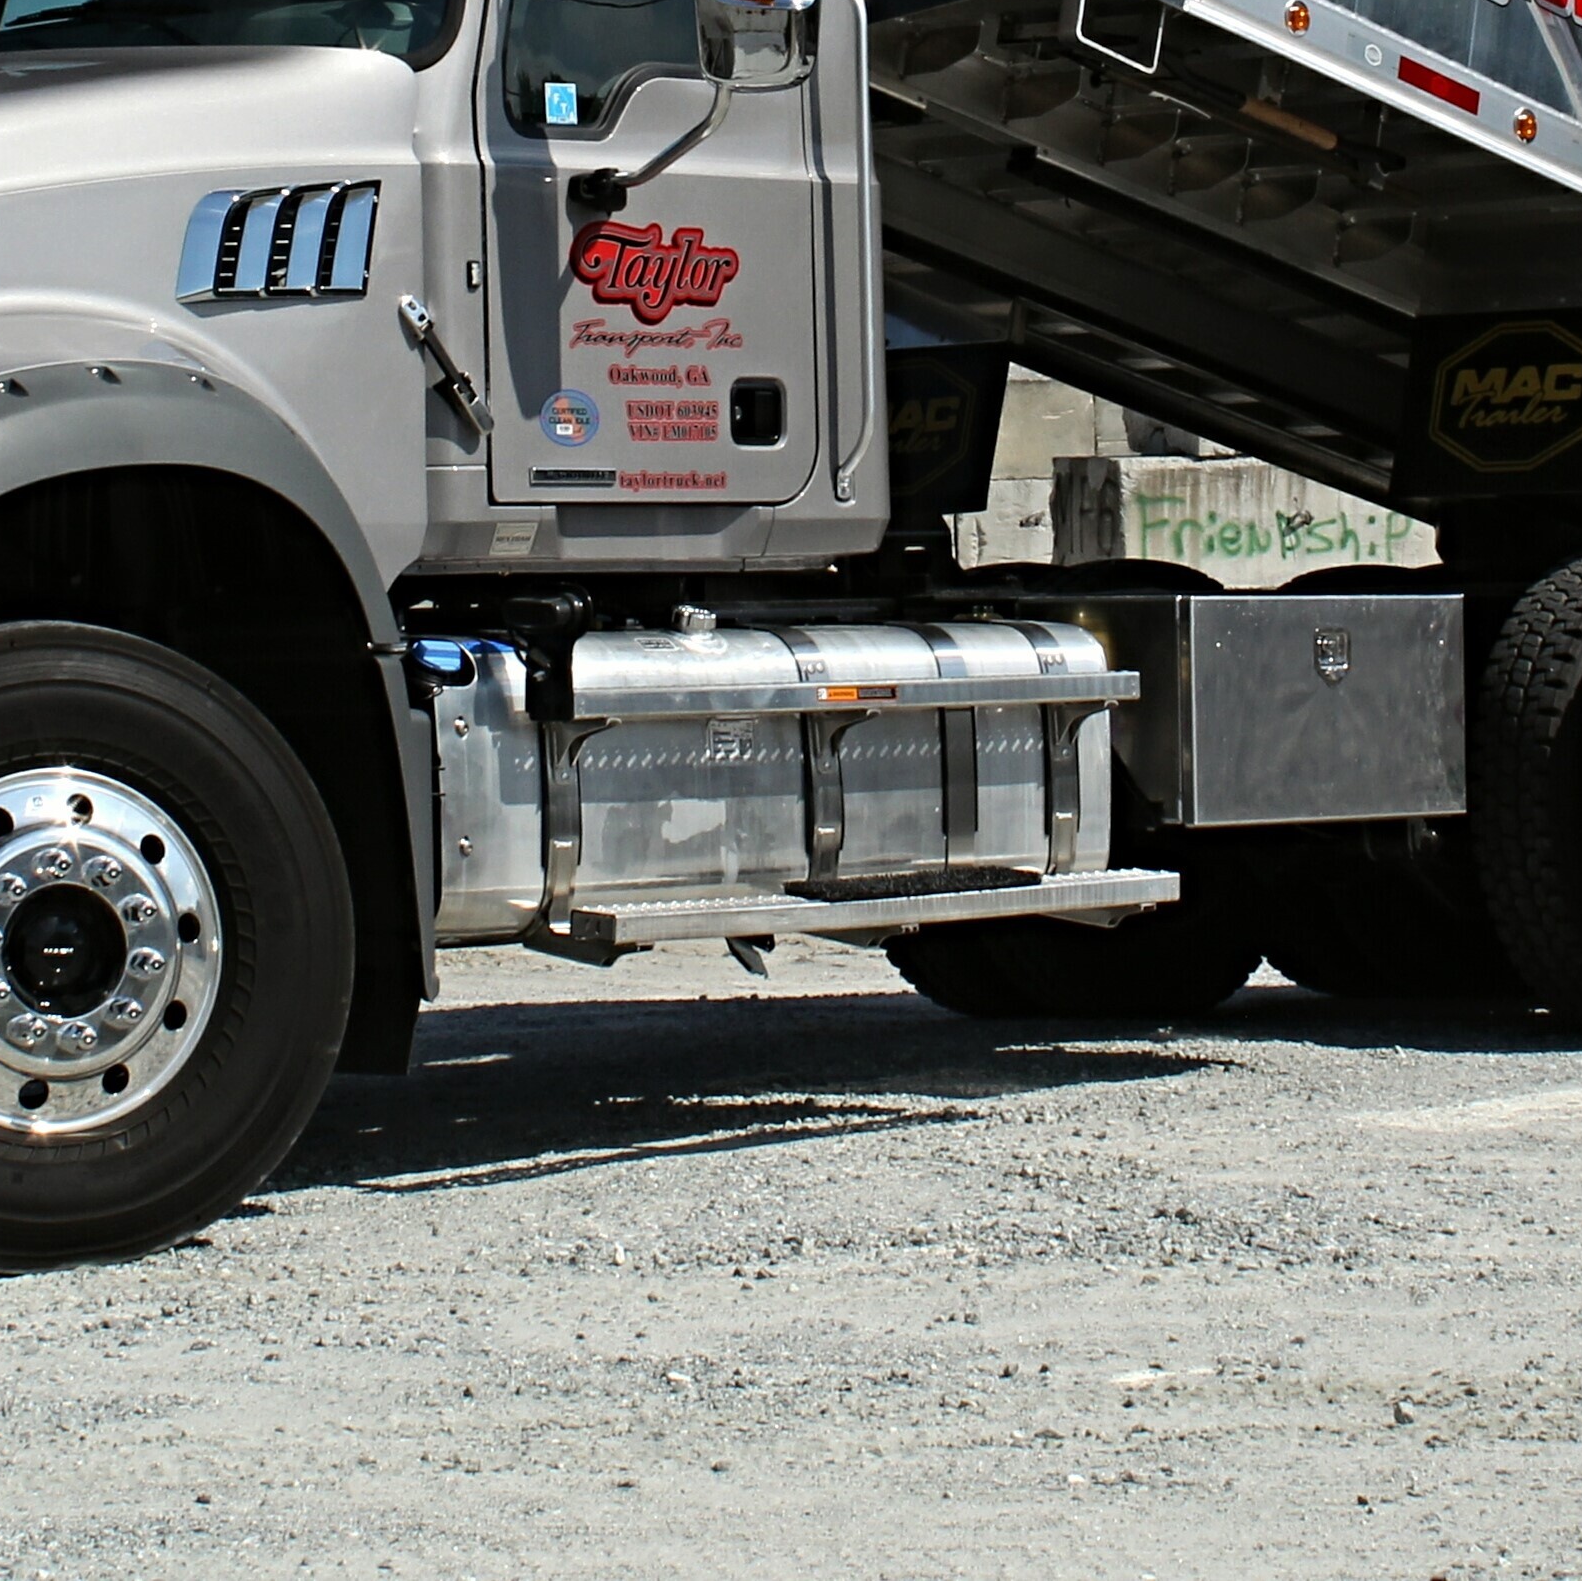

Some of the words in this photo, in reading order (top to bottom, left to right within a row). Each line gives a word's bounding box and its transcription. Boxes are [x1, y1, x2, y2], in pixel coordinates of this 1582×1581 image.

[579, 229, 735, 312] Taylor
[609, 366, 682, 386] Oakwood,
[686, 366, 711, 384] GA
[627, 403, 672, 418] USDOT
[1458, 390, 1568, 429] Trailer
[629, 423, 659, 439] VIN#
[620, 471, 725, 491] taylortruck.net
